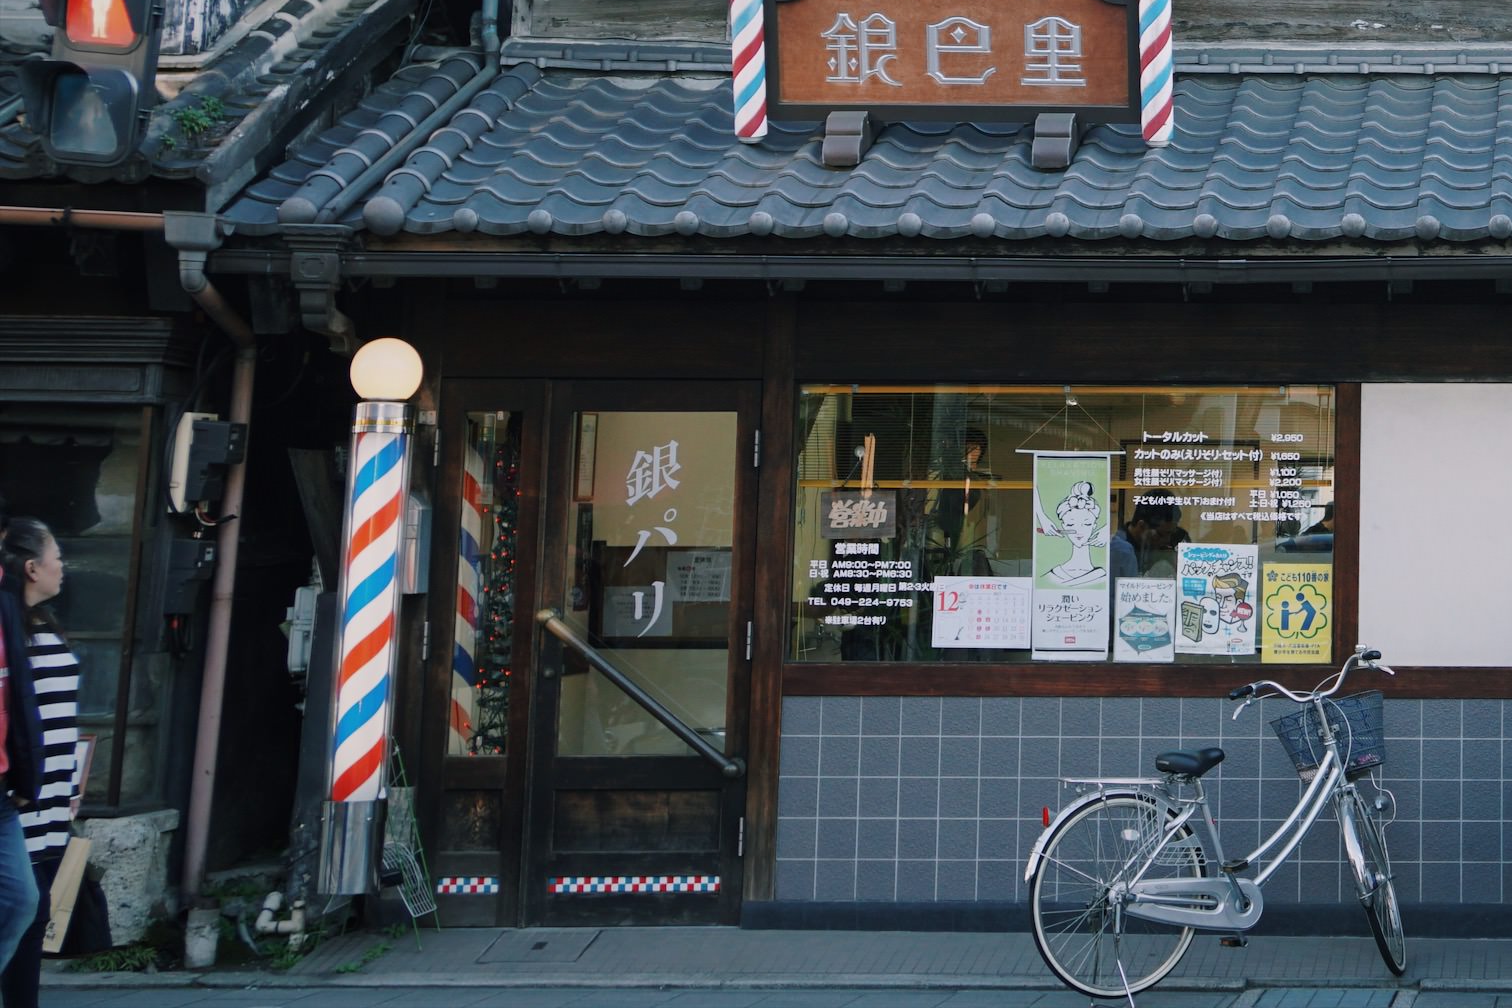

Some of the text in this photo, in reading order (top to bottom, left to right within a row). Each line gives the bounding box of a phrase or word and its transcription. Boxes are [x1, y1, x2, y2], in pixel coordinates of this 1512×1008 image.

[819, 11, 1088, 87] 銀巴里
[1143, 431, 1208, 443] トータルカット
[1250, 490, 1266, 498] 平日
[829, 499, 887, 528] 営業中
[624, 439, 682, 638] 銀パリ
[835, 543, 879, 555] 営業時間
[810, 560, 827, 569] 平日
[1280, 572, 1329, 582] こども110番の家
[824, 583, 850, 592] 定休日
[808, 597, 826, 606] TEL
[937, 591, 960, 612] 12
[1061, 595, 1079, 603] 潤い
[1038, 604, 1103, 613] リラクゼーション
[1046, 614, 1095, 622] シェービング
